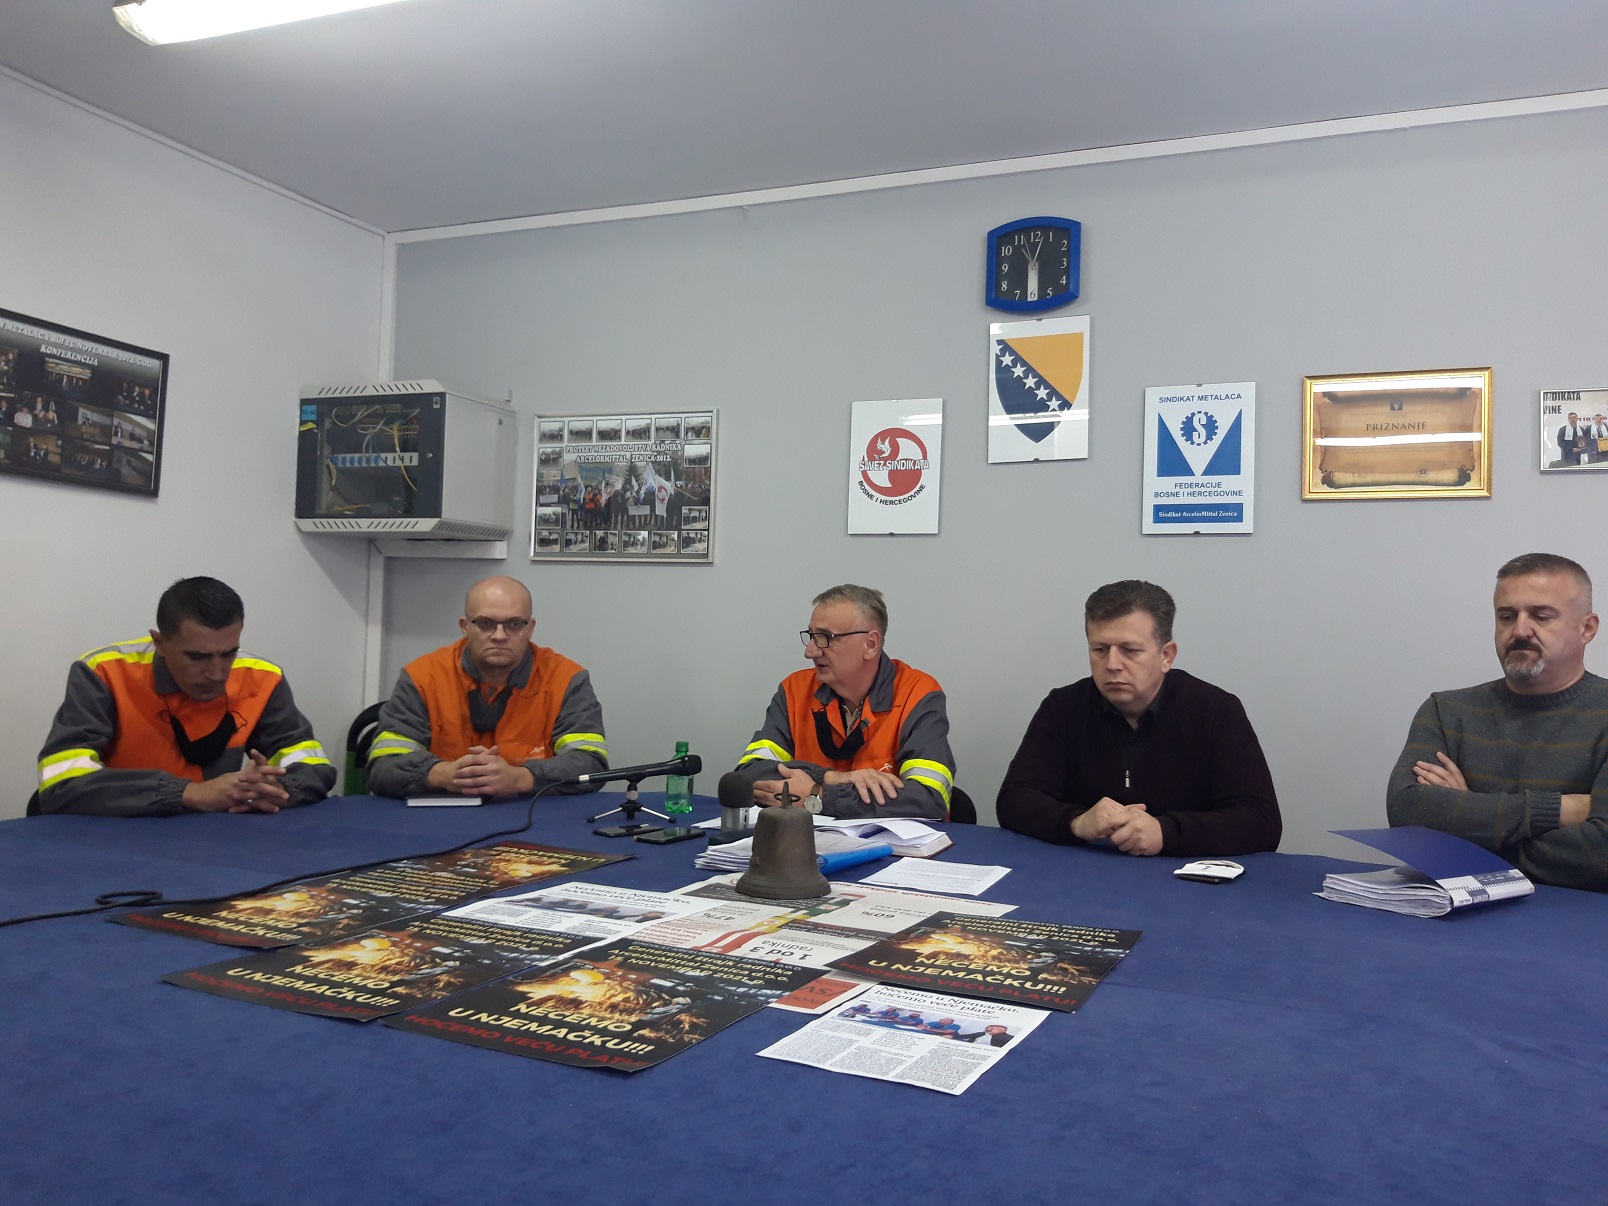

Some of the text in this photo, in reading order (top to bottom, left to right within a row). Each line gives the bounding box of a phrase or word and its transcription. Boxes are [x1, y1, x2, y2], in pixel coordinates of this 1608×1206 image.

[1014, 235, 1024, 246] 11
[1030, 231, 1041, 242] 12
[1049, 232, 1053, 242] 1
[1061, 240, 1068, 250] 2
[1001, 246, 1012, 256] 10
[1060, 258, 1066, 268] 3
[1002, 264, 1008, 274] 9
[1060, 275, 1066, 286] 4
[1001, 281, 1008, 292] 8
[1014, 290, 1020, 300] 7
[1030, 290, 1036, 299] 6
[1046, 288, 1053, 298] 5
[40, 344, 98, 366] KONFERENCIJA
[1158, 393, 1242, 404] SINDIKAT METALACA
[1366, 422, 1427, 432] PRIZNANJE
[565, 445, 594, 454] PROTEST
[652, 442, 682, 452] RADNIKA
[859, 459, 930, 472] SAVEZ SINDIKATA
[1174, 482, 1222, 490] FEDERACIJE
[858, 480, 875, 502] BOSNE
[880, 484, 926, 506] HERCEGOVINE
[1187, 490, 1244, 498] HERCEGOVINE
[1062, 927, 1116, 938] radnika
[762, 940, 814, 952] radnika
[764, 948, 795, 957] od
[608, 949, 699, 966] ArcelorMittal
[700, 963, 750, 974] Zenica
[628, 945, 694, 959] Generalni
[737, 962, 793, 975] radnika
[626, 958, 713, 976] NOVEMBAR
[868, 960, 1068, 994] U NJEMAČKU!!!
[226, 967, 401, 1007] U NJEMAČKU!!!
[882, 986, 934, 999] Nećemo
[875, 990, 927, 1003] hoćemo
[960, 1006, 996, 1014] plate
[448, 1008, 656, 1055] U NJEMAČKU!!!
